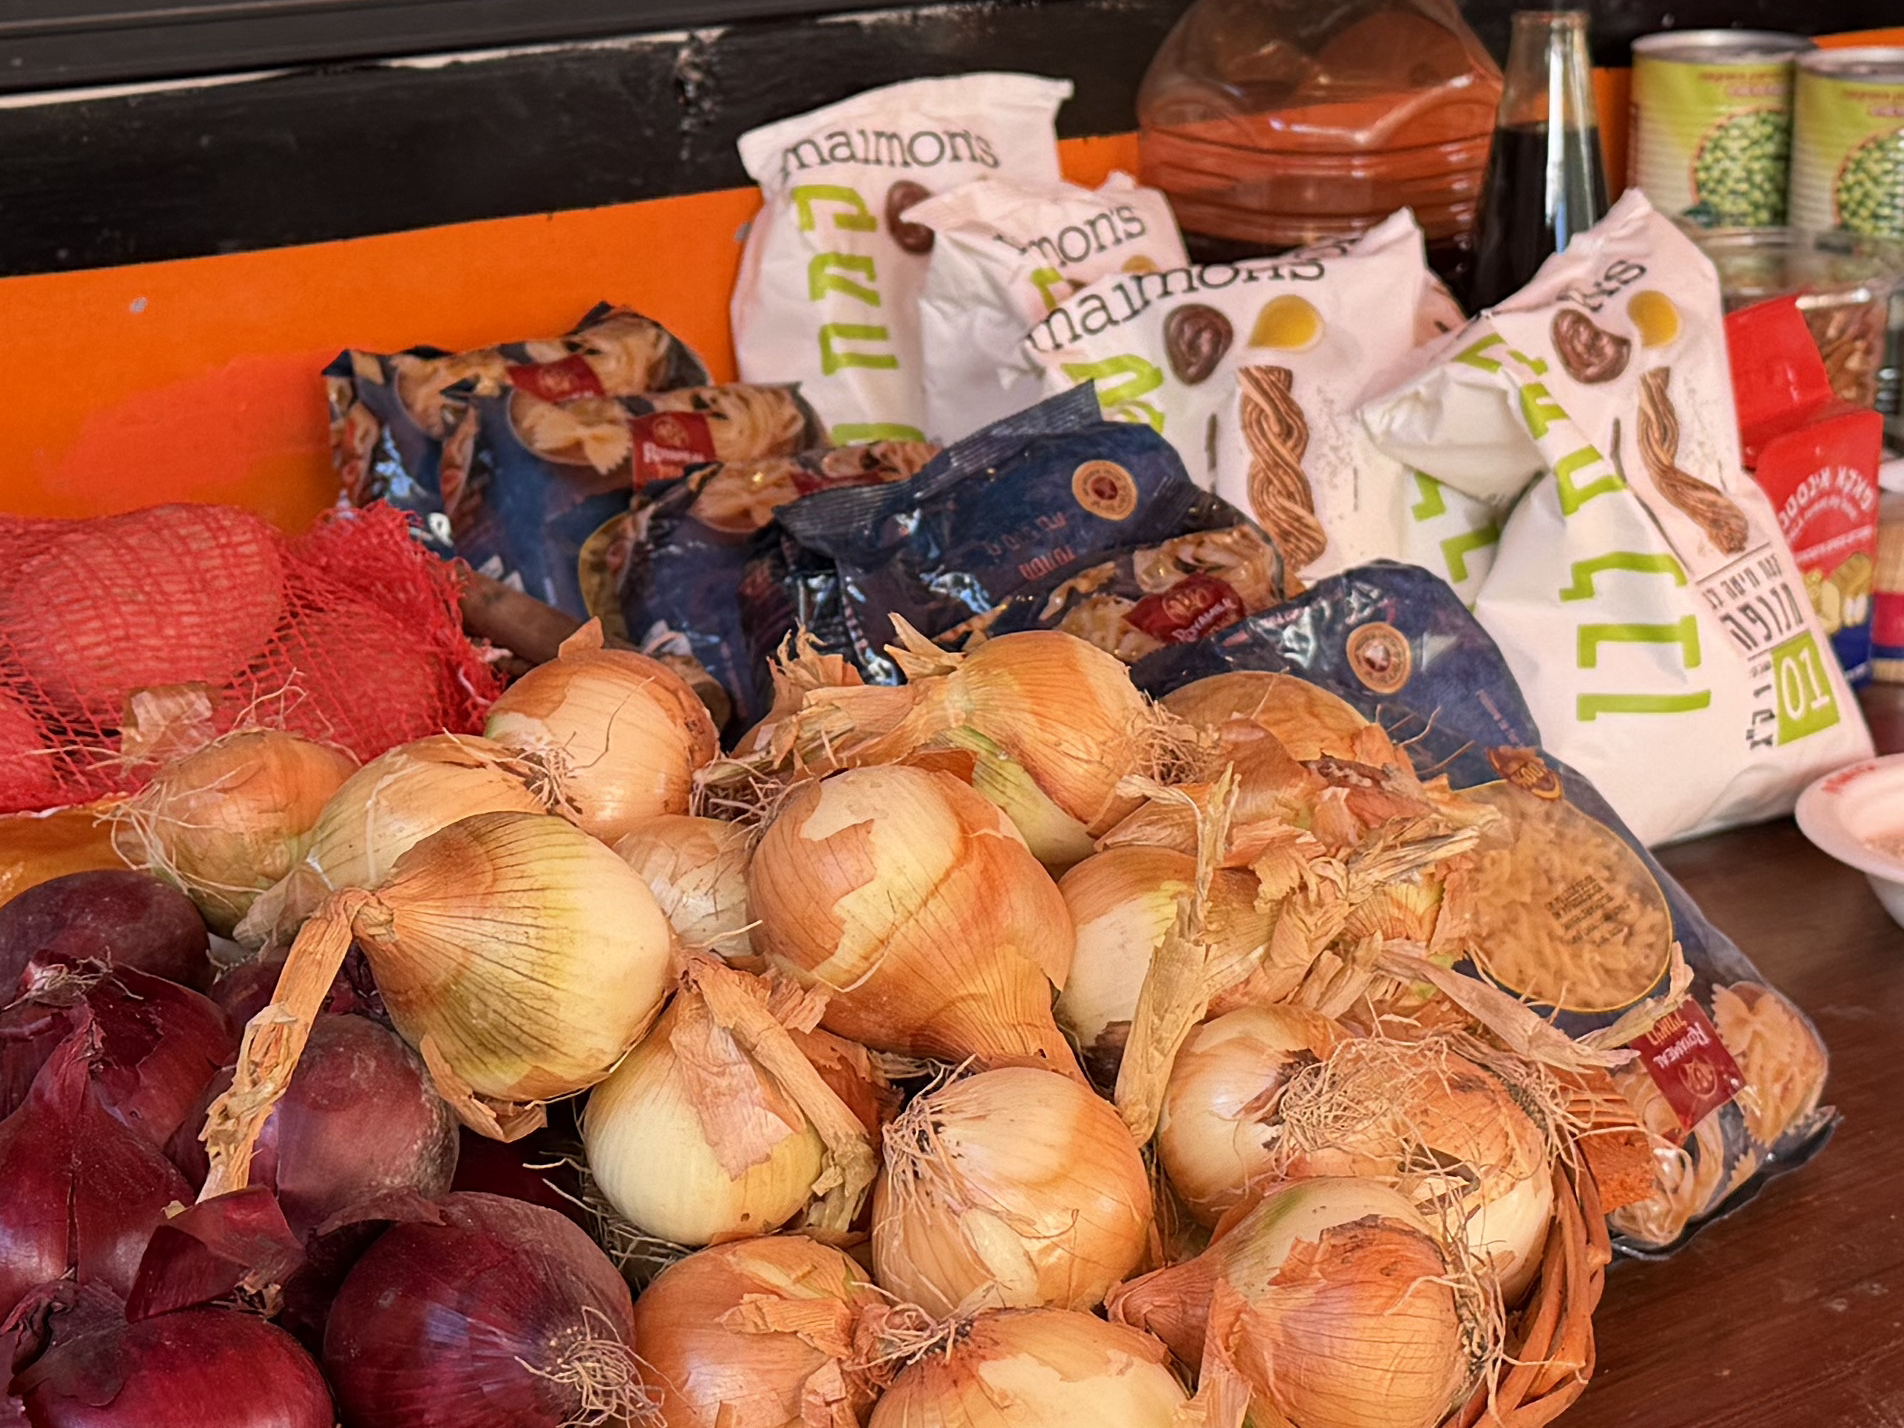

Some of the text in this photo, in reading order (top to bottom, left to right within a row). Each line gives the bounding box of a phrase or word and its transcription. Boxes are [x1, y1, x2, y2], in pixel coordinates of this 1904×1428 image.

[791, 183, 900, 378] קמח
[1559, 551, 1711, 722] לבן
[1780, 646, 1832, 721] 01
